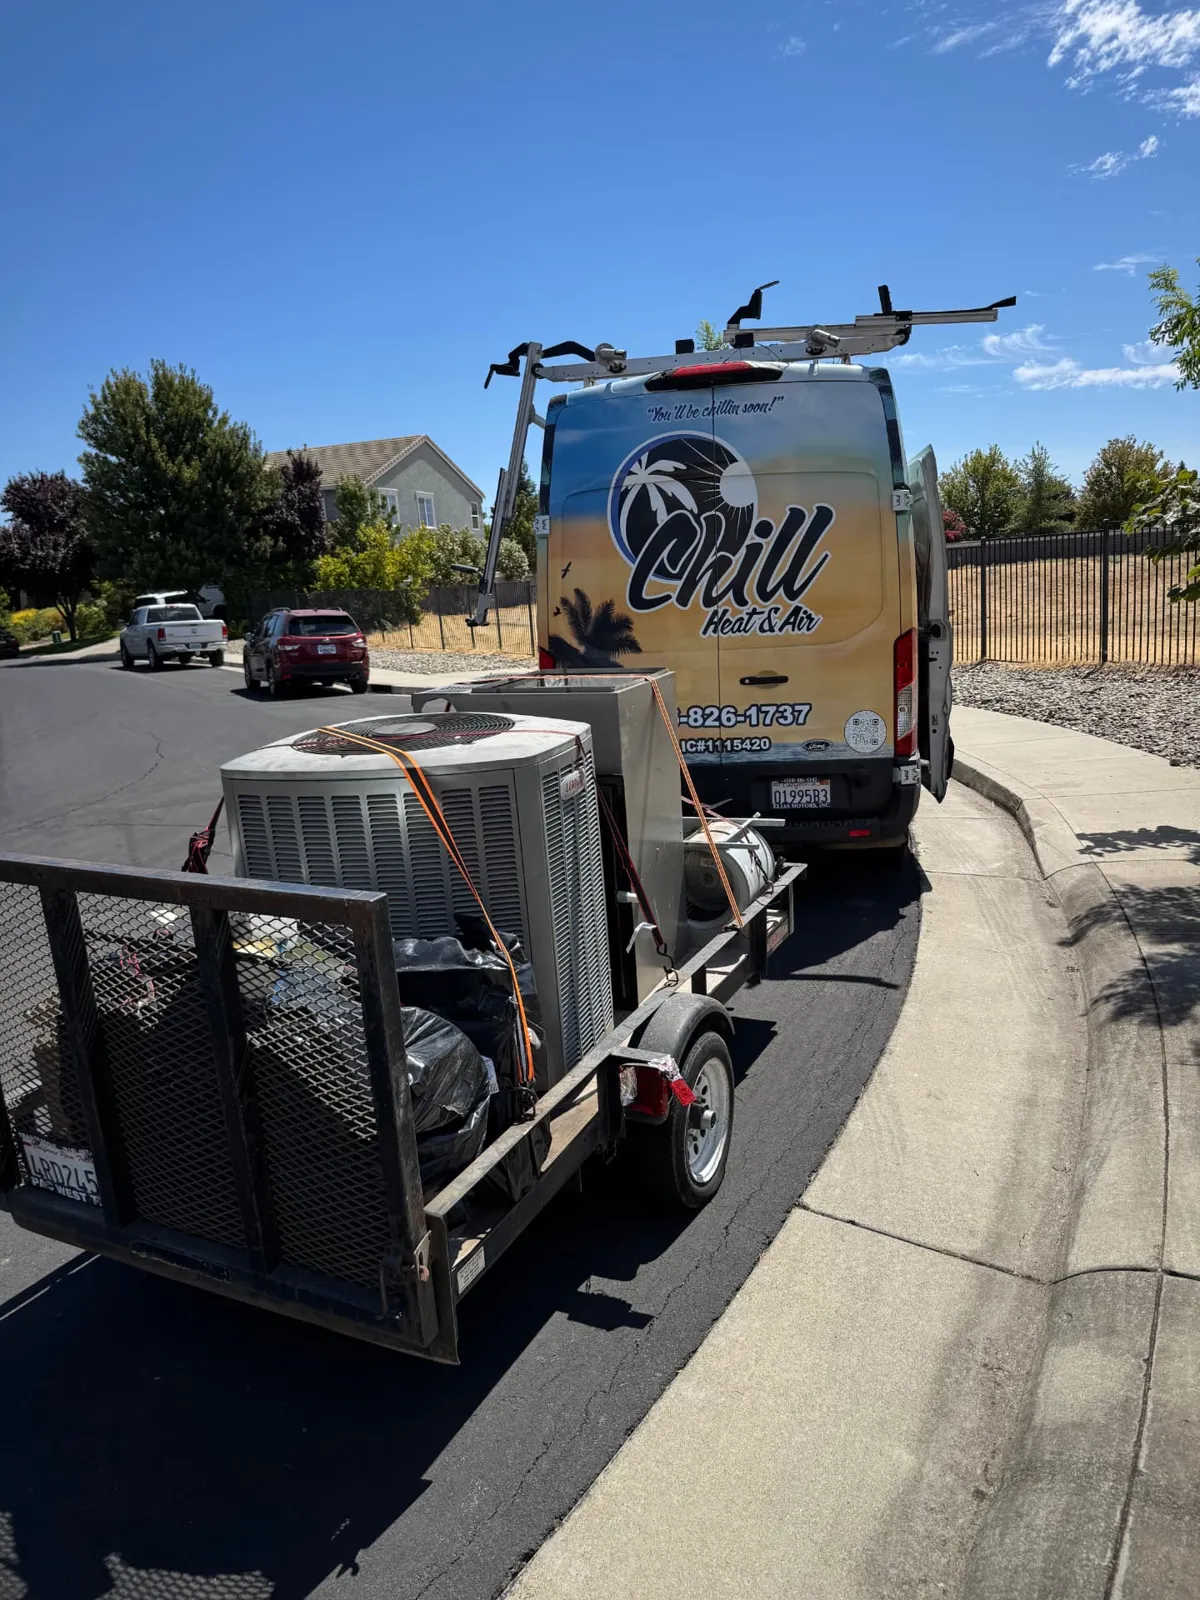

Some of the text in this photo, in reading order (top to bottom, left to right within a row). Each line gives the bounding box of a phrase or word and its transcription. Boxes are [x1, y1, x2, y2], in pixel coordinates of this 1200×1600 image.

[687, 404, 700, 419] be
[701, 399, 740, 417] chillin
[627, 503, 835, 613] Chill
[701, 604, 821, 636] Heat & Air
[678, 703, 812, 728] -826-1737
[680, 736, 772, 753] IC#1115420
[773, 788, 828, 804] 01995B3
[30, 1154, 99, 1195] 4RD245
[54, 1184, 87, 1203] WEST
